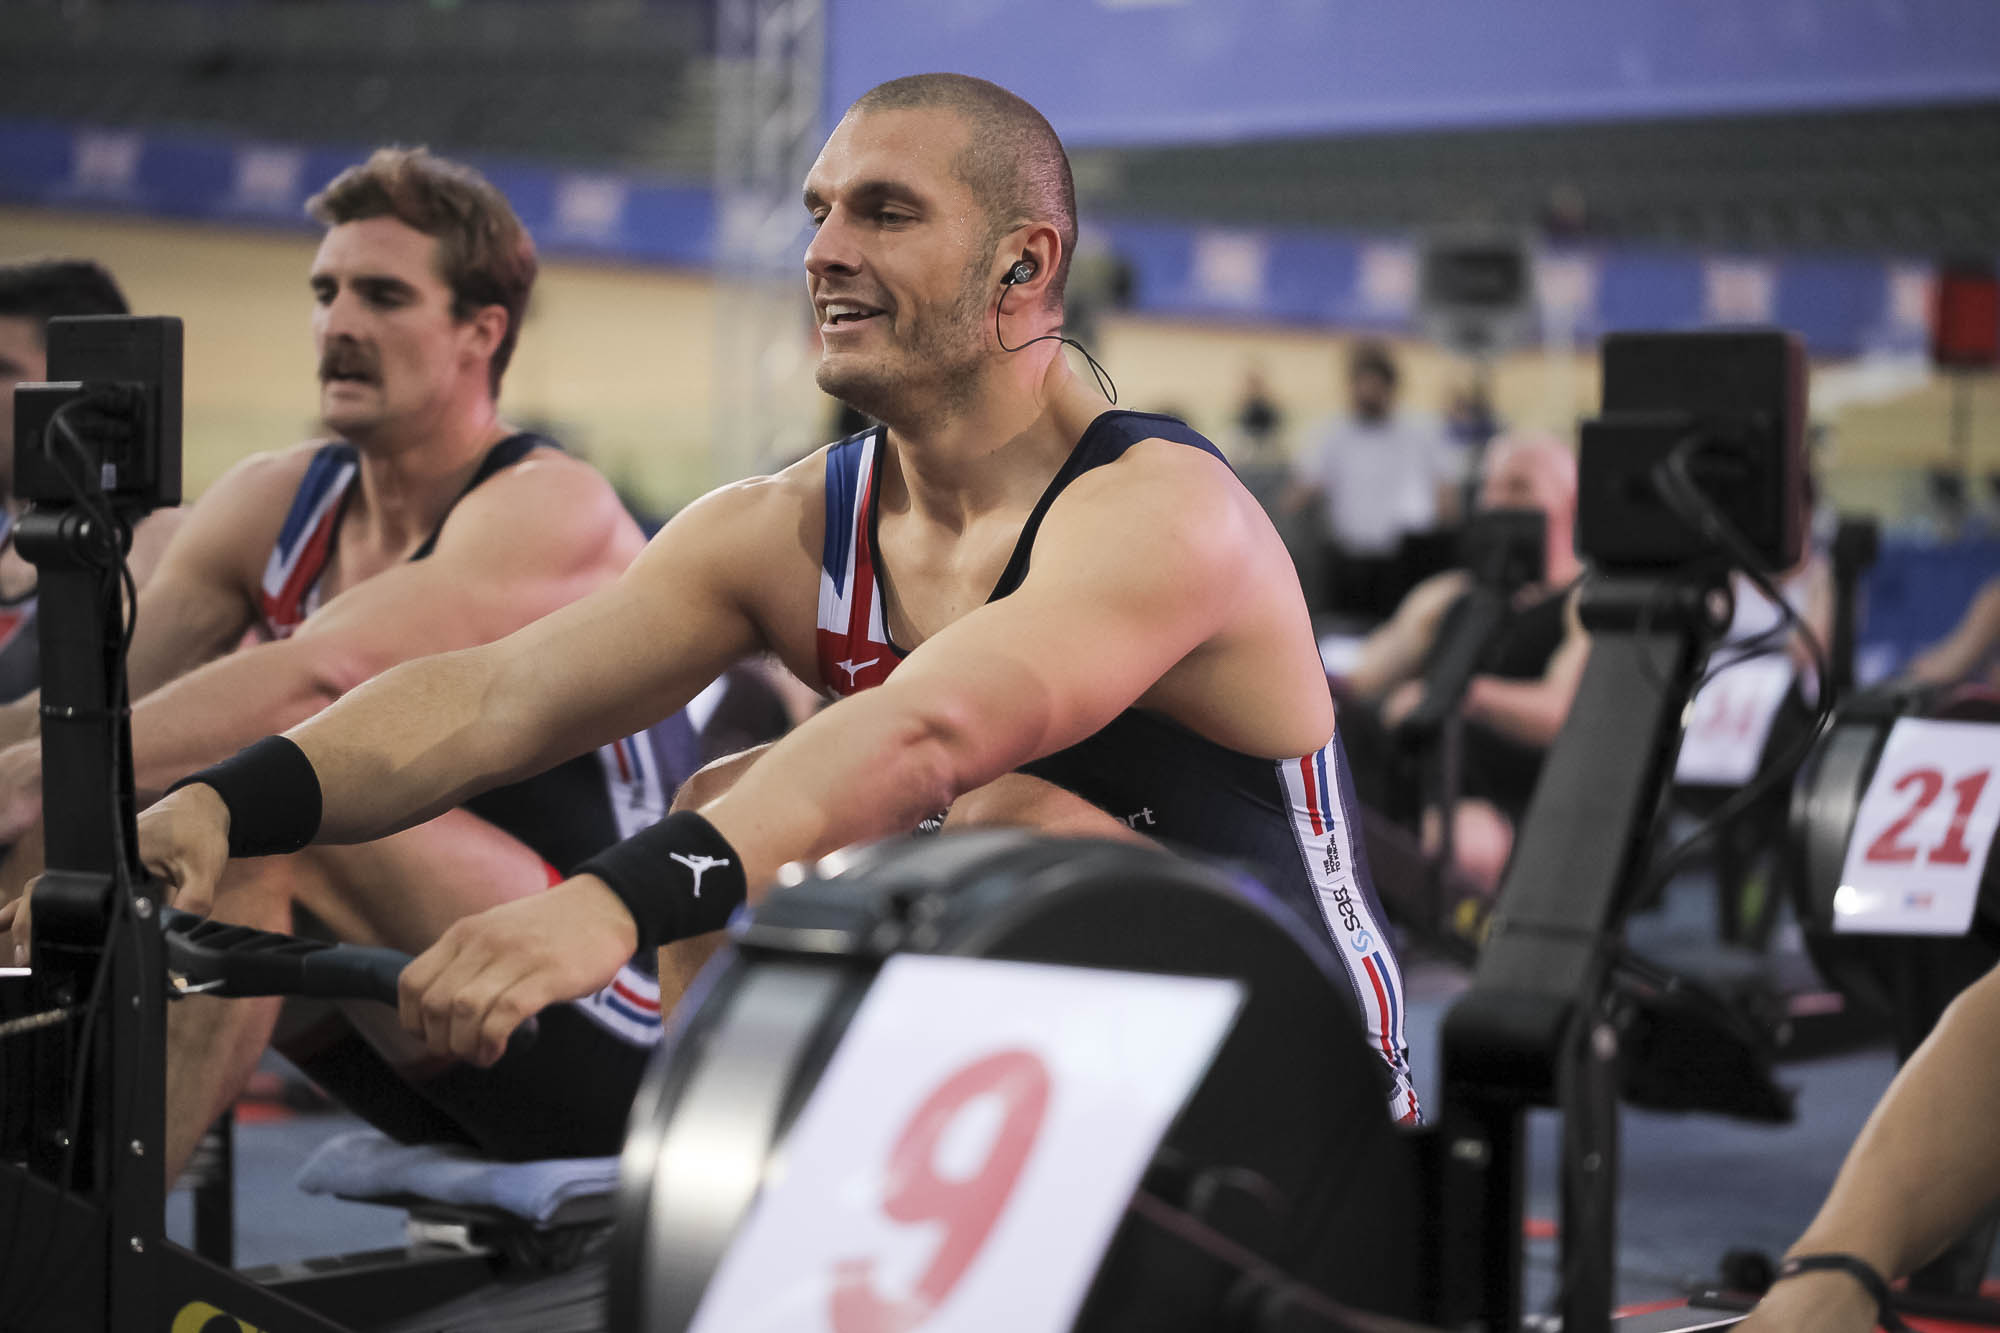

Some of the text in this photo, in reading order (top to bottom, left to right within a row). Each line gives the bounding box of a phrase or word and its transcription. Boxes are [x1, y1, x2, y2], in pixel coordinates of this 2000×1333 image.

[1866, 768, 1992, 865] 21
[1323, 860, 1331, 876] THE
[829, 1050, 1052, 1333] 9
